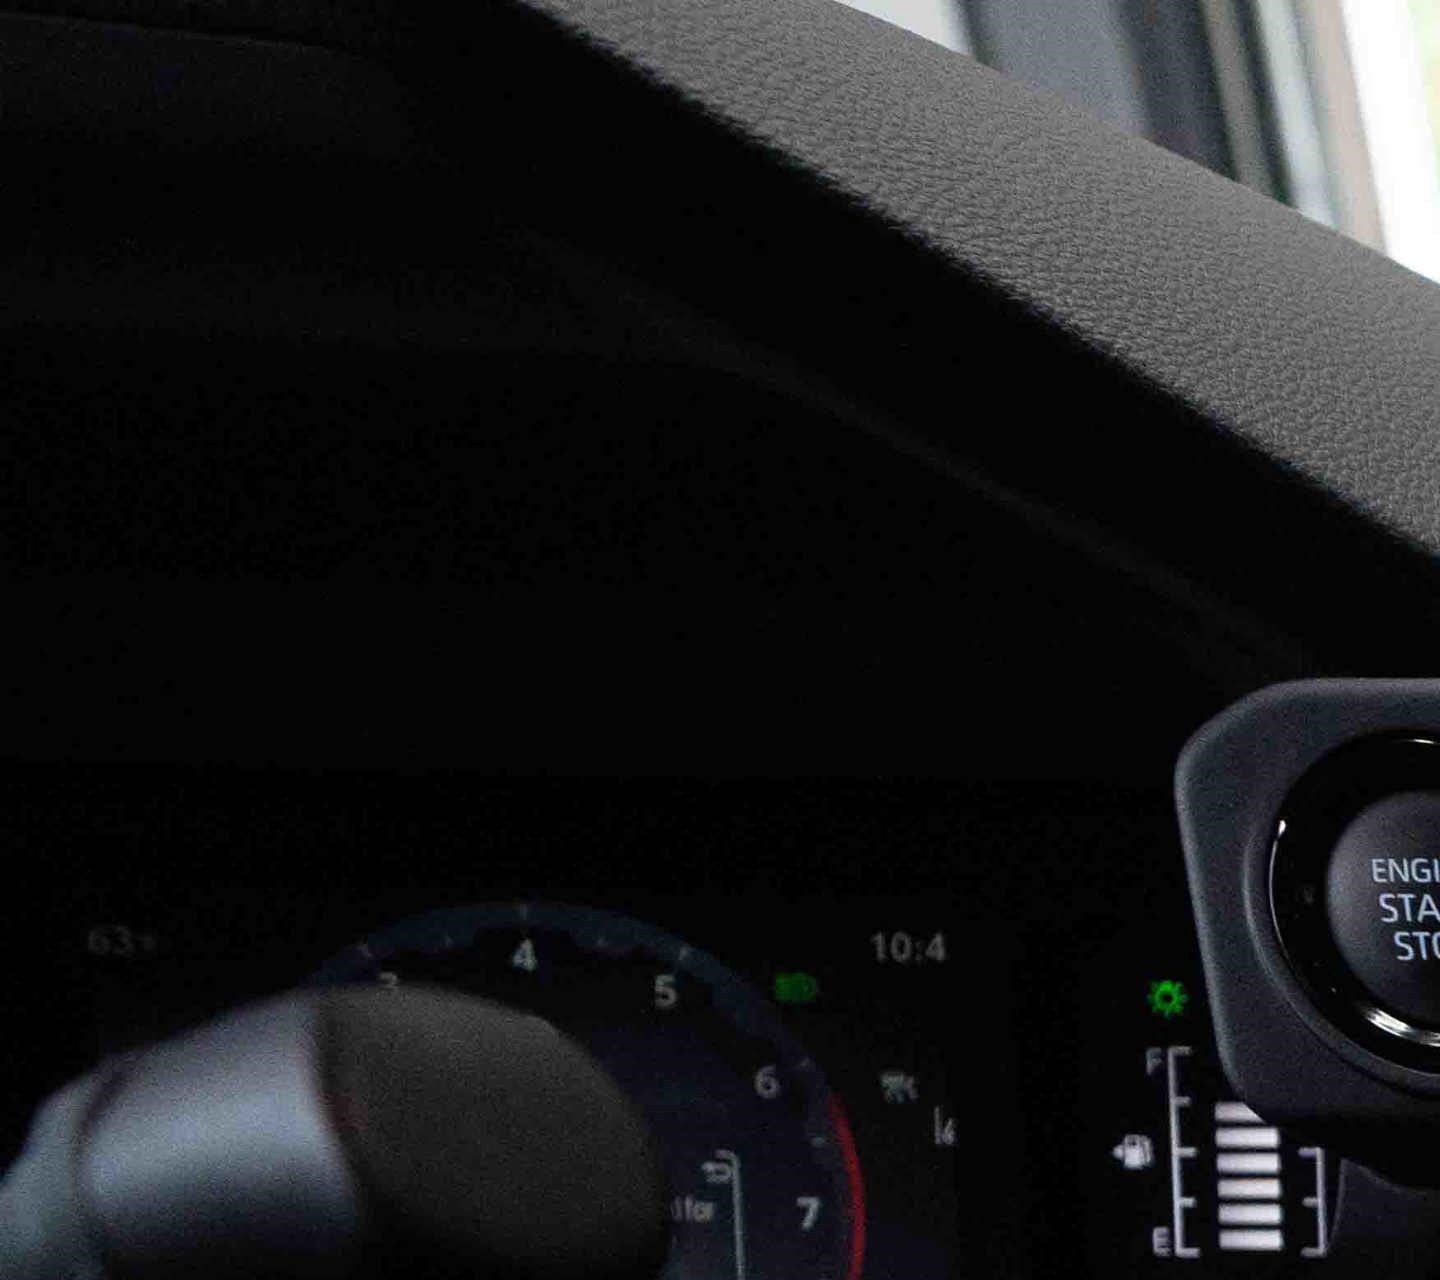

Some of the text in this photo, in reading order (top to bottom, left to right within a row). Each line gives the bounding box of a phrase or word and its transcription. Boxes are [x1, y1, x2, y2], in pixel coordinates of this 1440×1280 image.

[511, 937, 539, 974] 4
[653, 974, 678, 1010] 5
[754, 1065, 781, 1099] 6
[796, 1196, 822, 1231] 7
[1151, 1225, 1170, 1257] E
